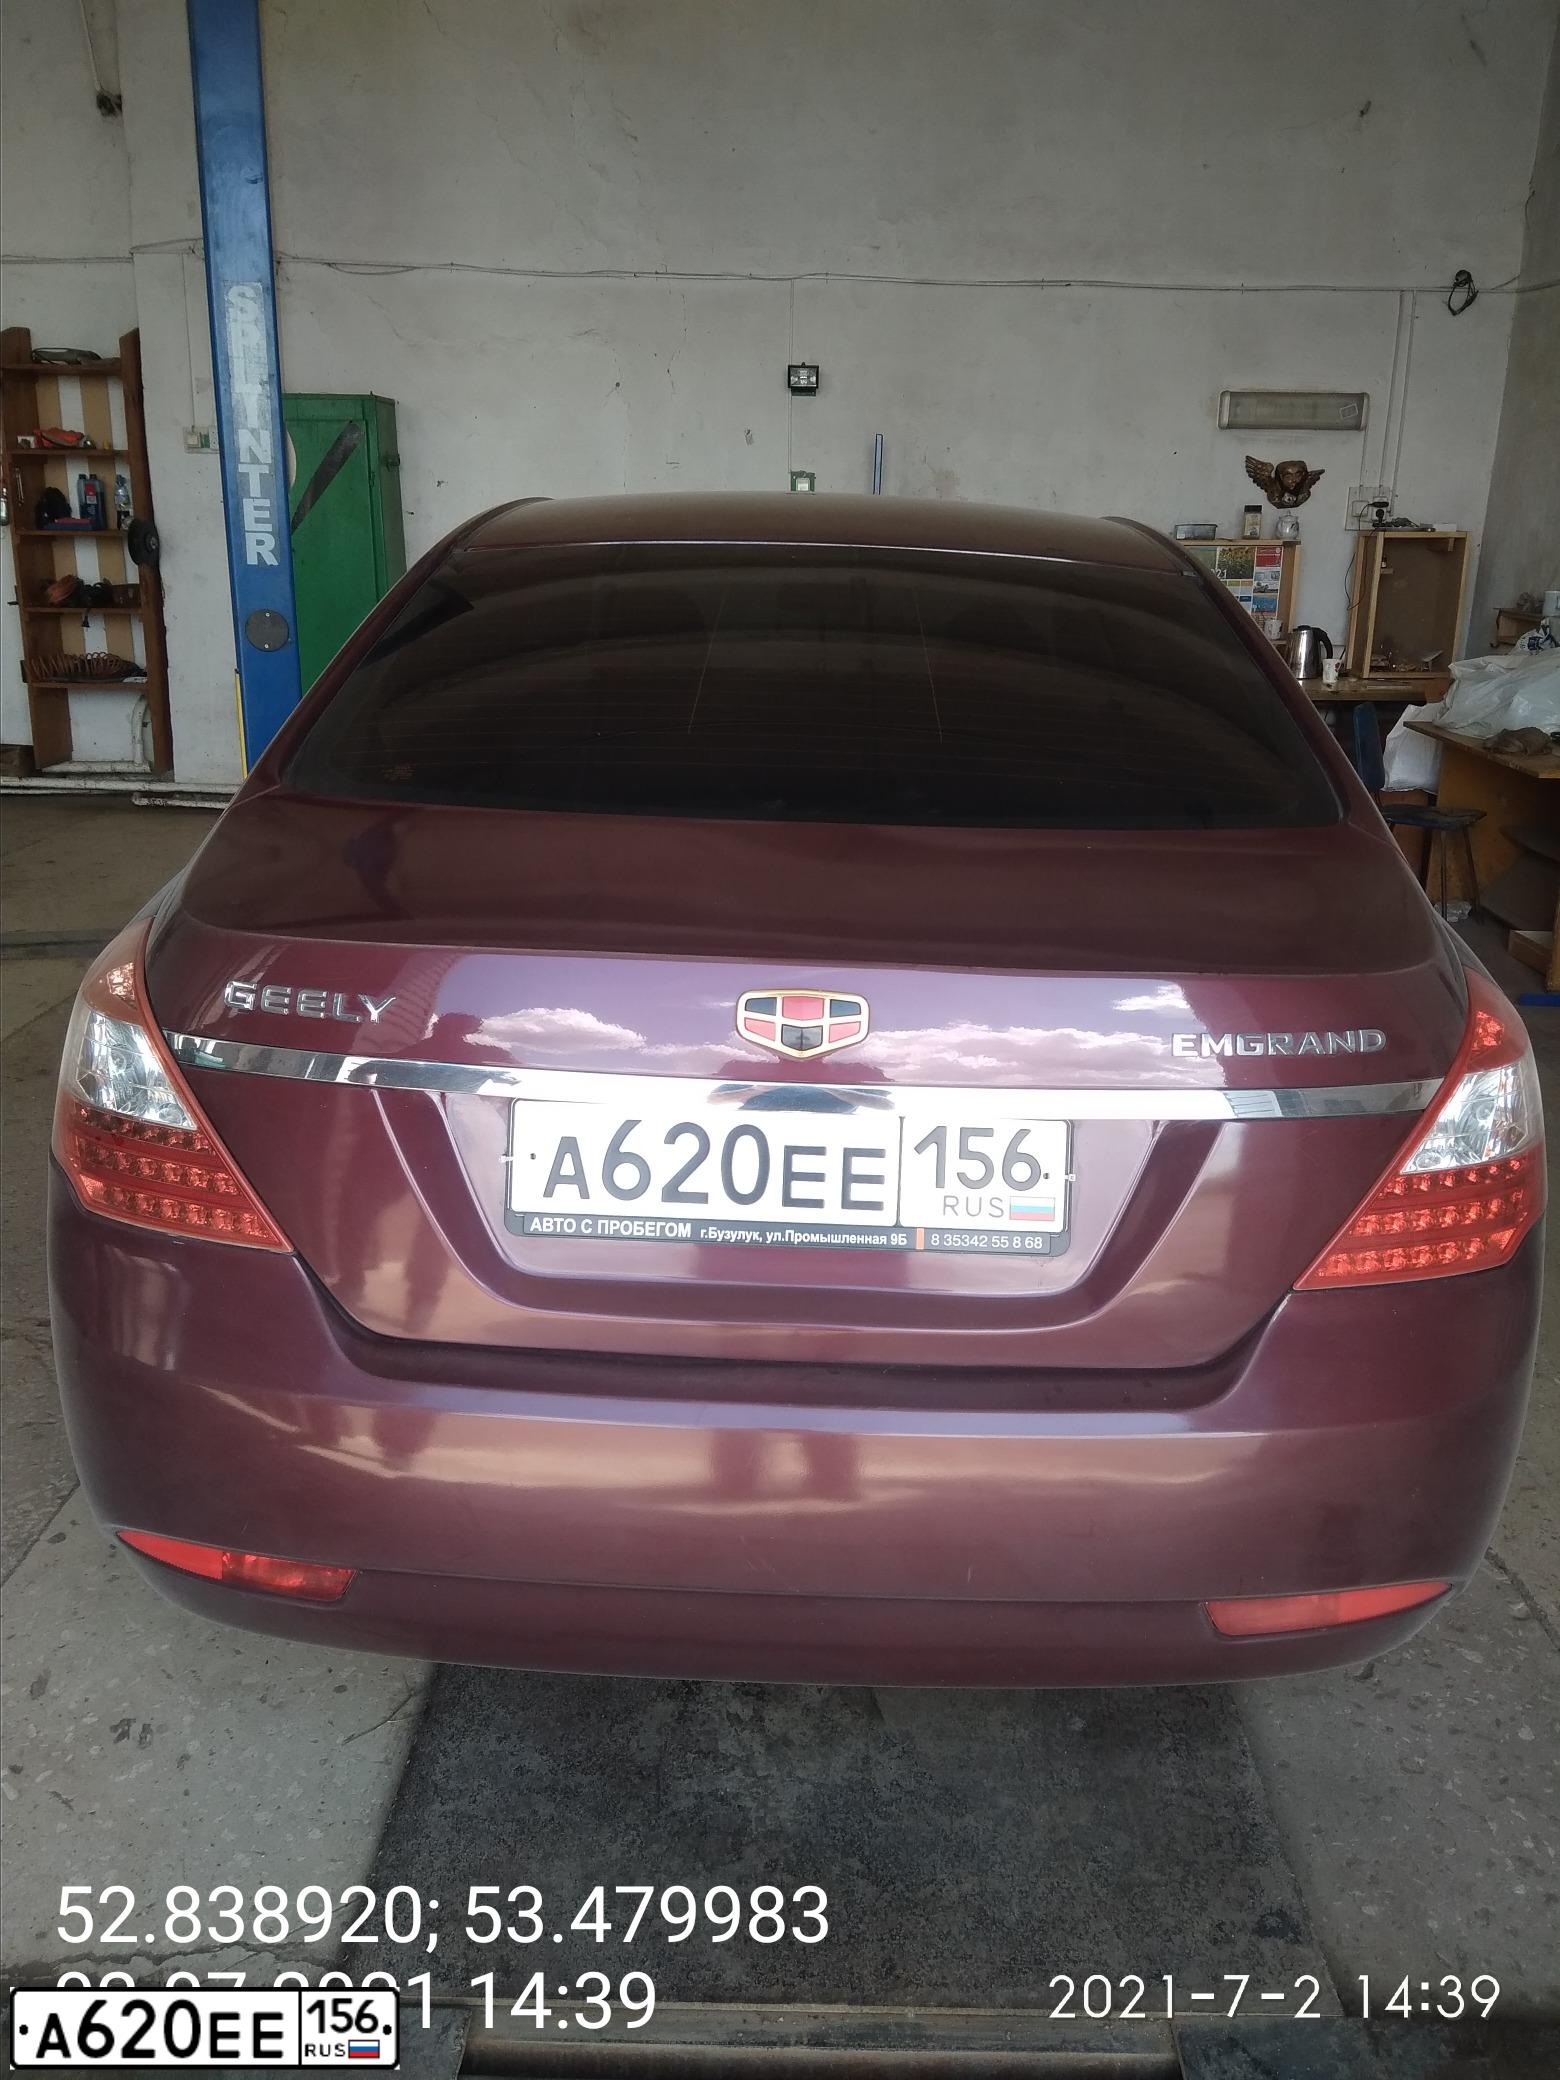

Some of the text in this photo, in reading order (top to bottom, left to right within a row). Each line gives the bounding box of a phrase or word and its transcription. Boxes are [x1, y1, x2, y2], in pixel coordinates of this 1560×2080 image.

[224, 980, 396, 1024] GEELY
[1171, 1029, 1387, 1057] EMGRAND
[913, 1125, 1042, 1192] 156
[942, 1194, 1005, 1219] RUS
[530, 1217, 1043, 1250] АВТО С ПРОБЕГОМ г.Бузулук, ул.Промышленная 9Б 8 35342 55 8 68
